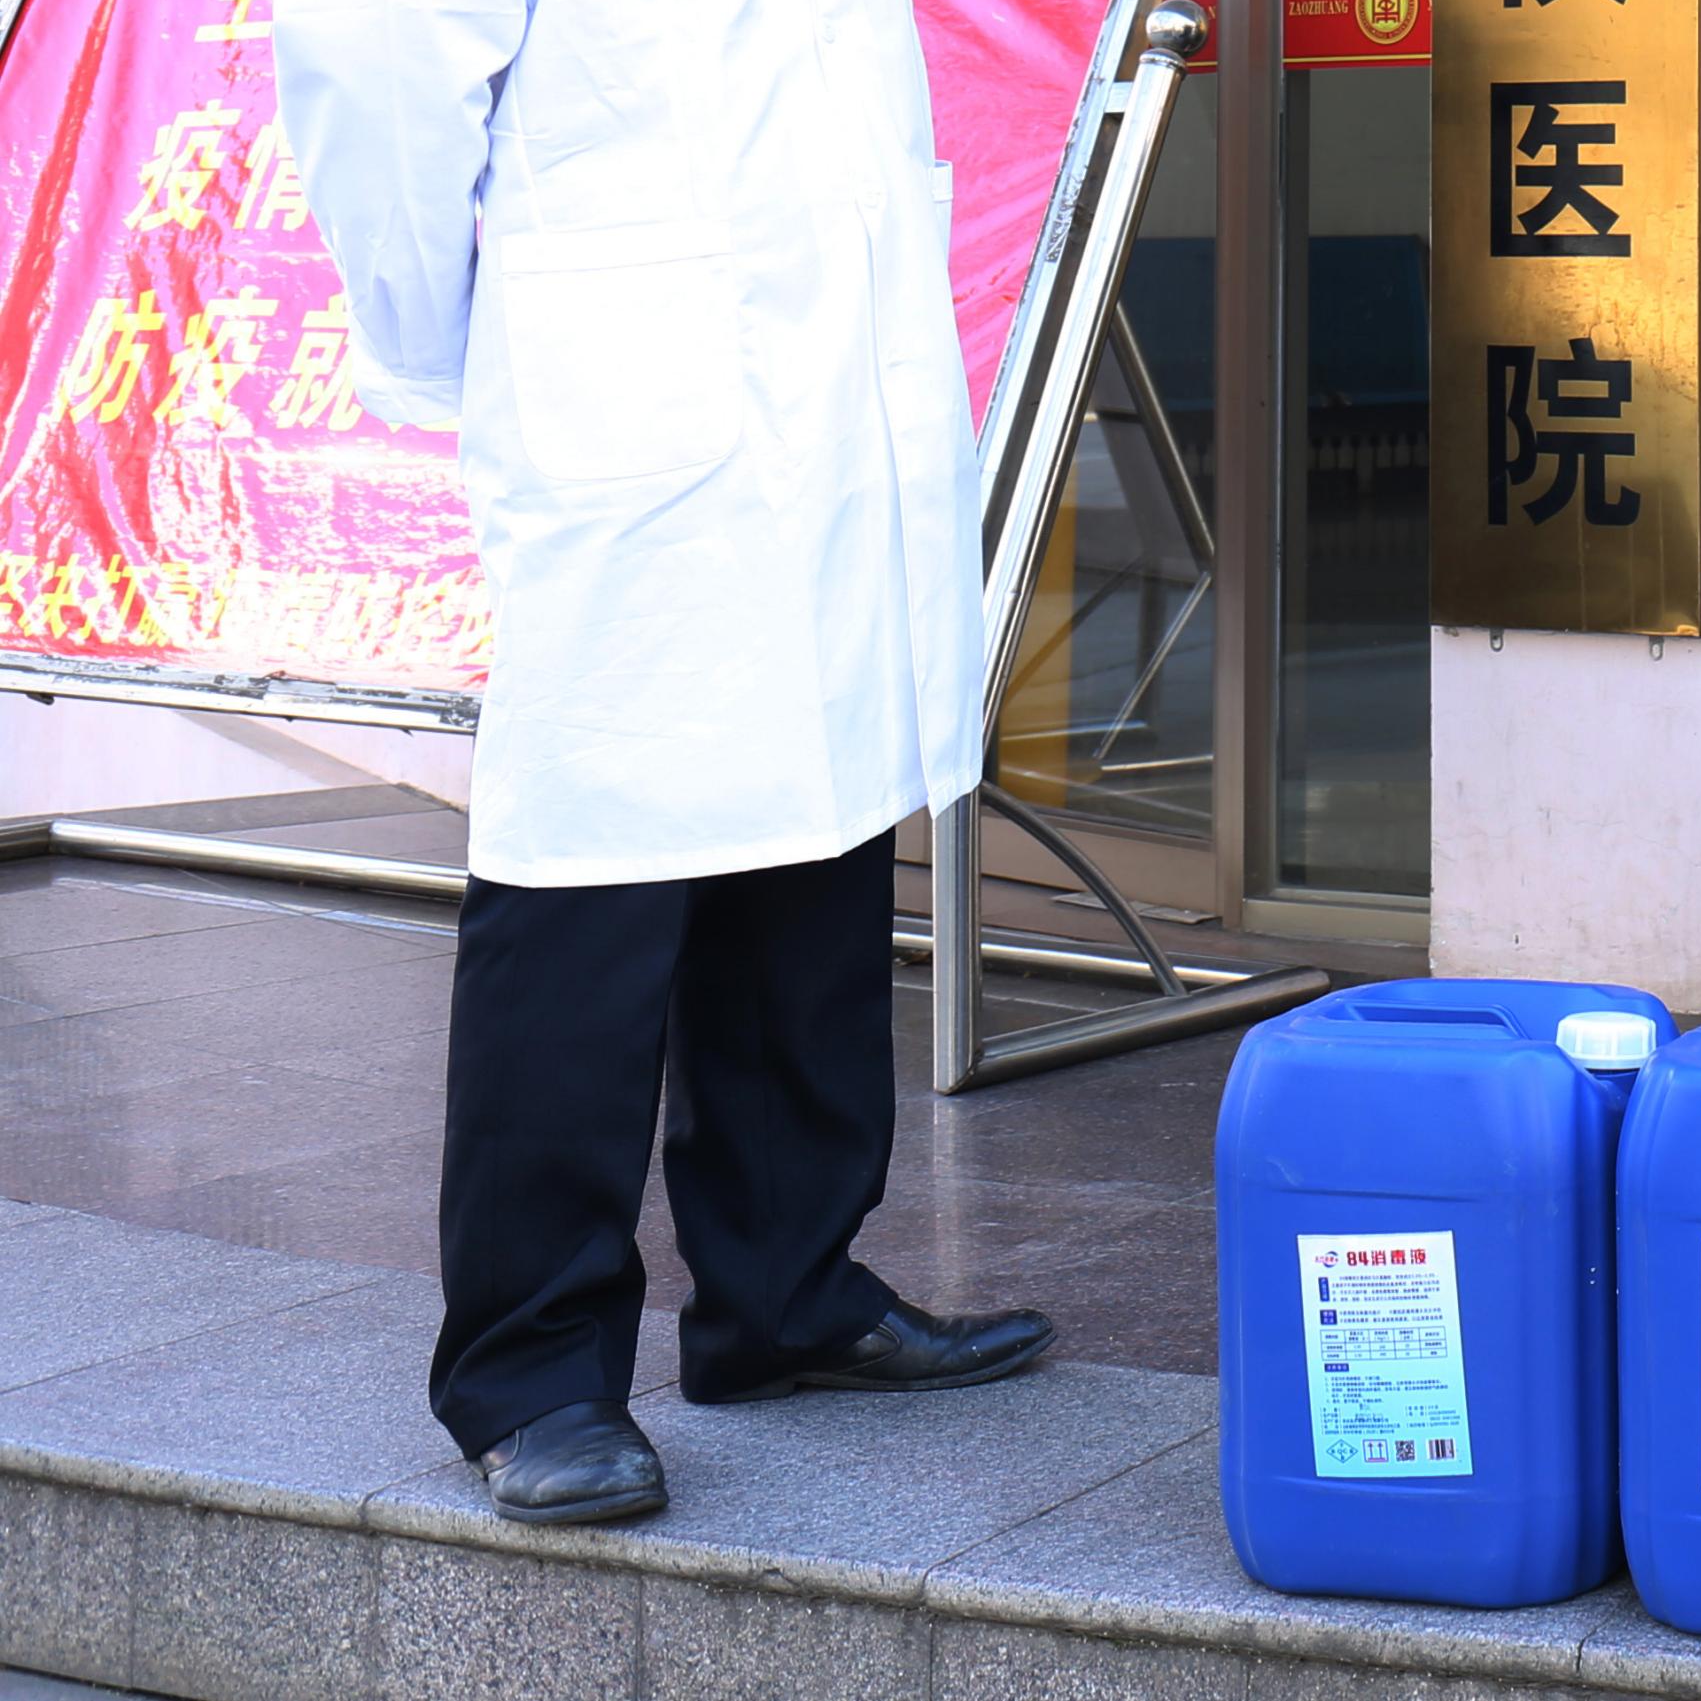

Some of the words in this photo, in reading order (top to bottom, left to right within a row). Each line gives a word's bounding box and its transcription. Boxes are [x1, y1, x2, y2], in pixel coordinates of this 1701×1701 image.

[1289, 0, 1349, 17] ZAOZHUANG
[1346, 1248, 1427, 1267] 84消毒液
